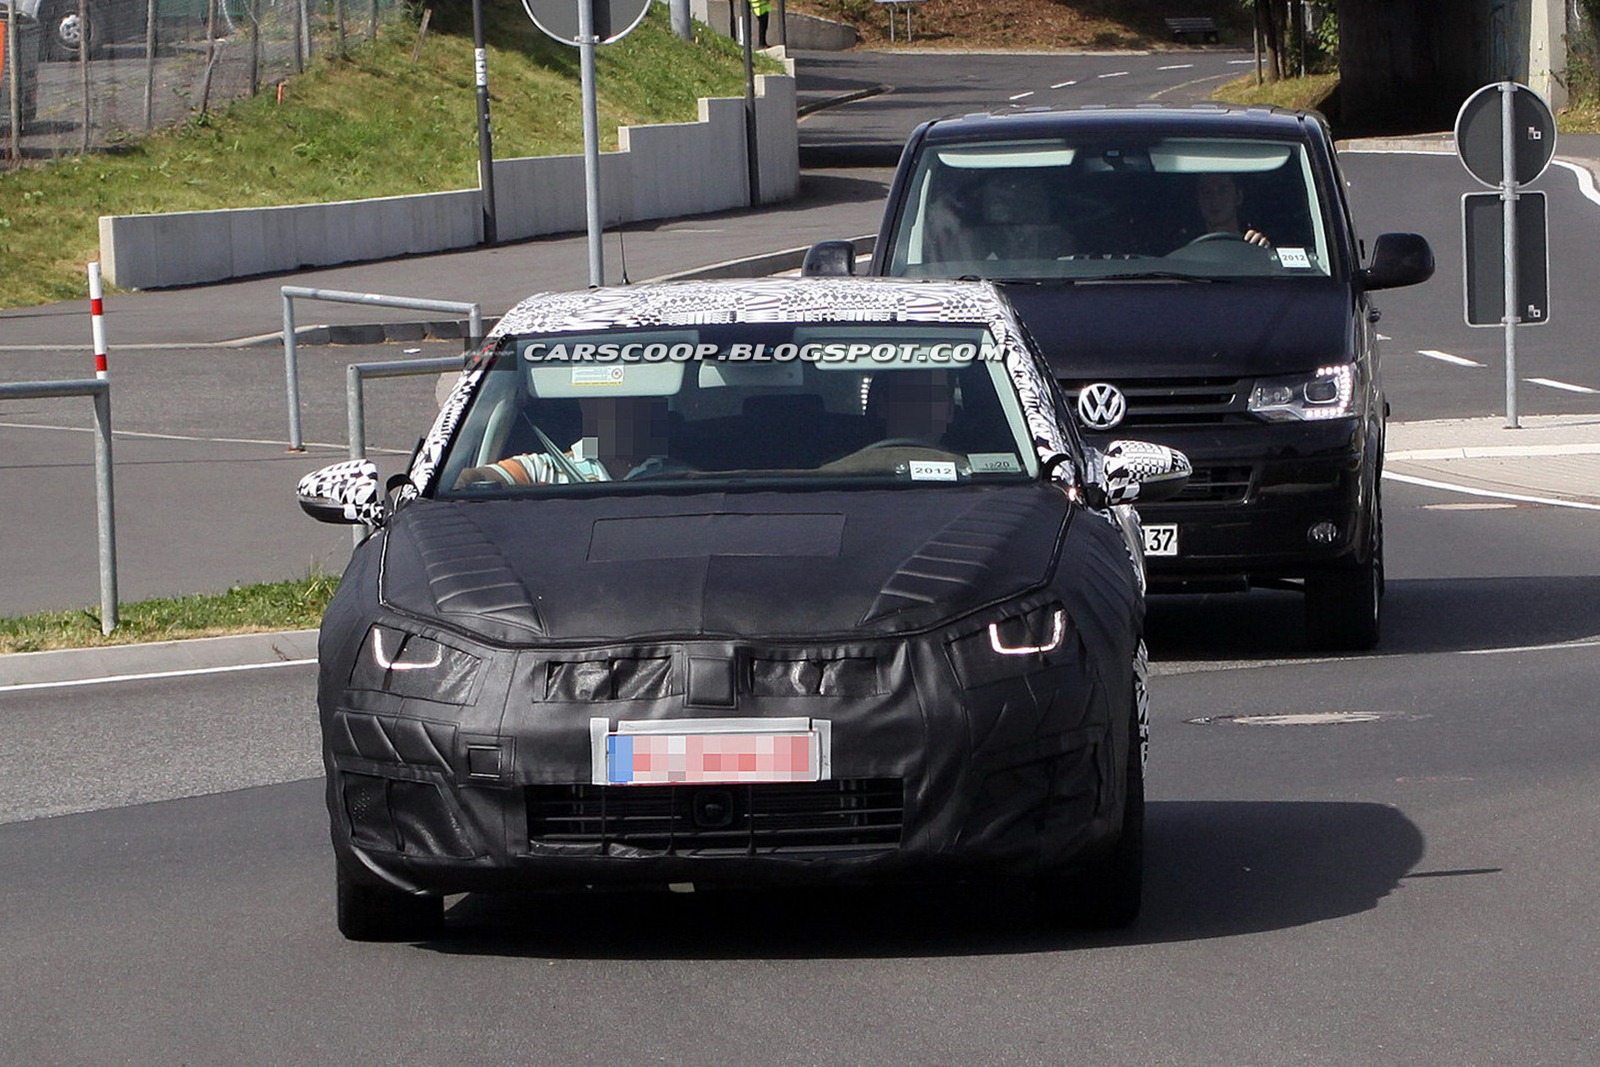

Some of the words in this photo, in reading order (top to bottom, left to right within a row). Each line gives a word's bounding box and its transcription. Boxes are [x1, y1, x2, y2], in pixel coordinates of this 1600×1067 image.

[1078, 383, 1126, 430] VW
[915, 467, 952, 475] 2012
[1143, 528, 1175, 551] 37
